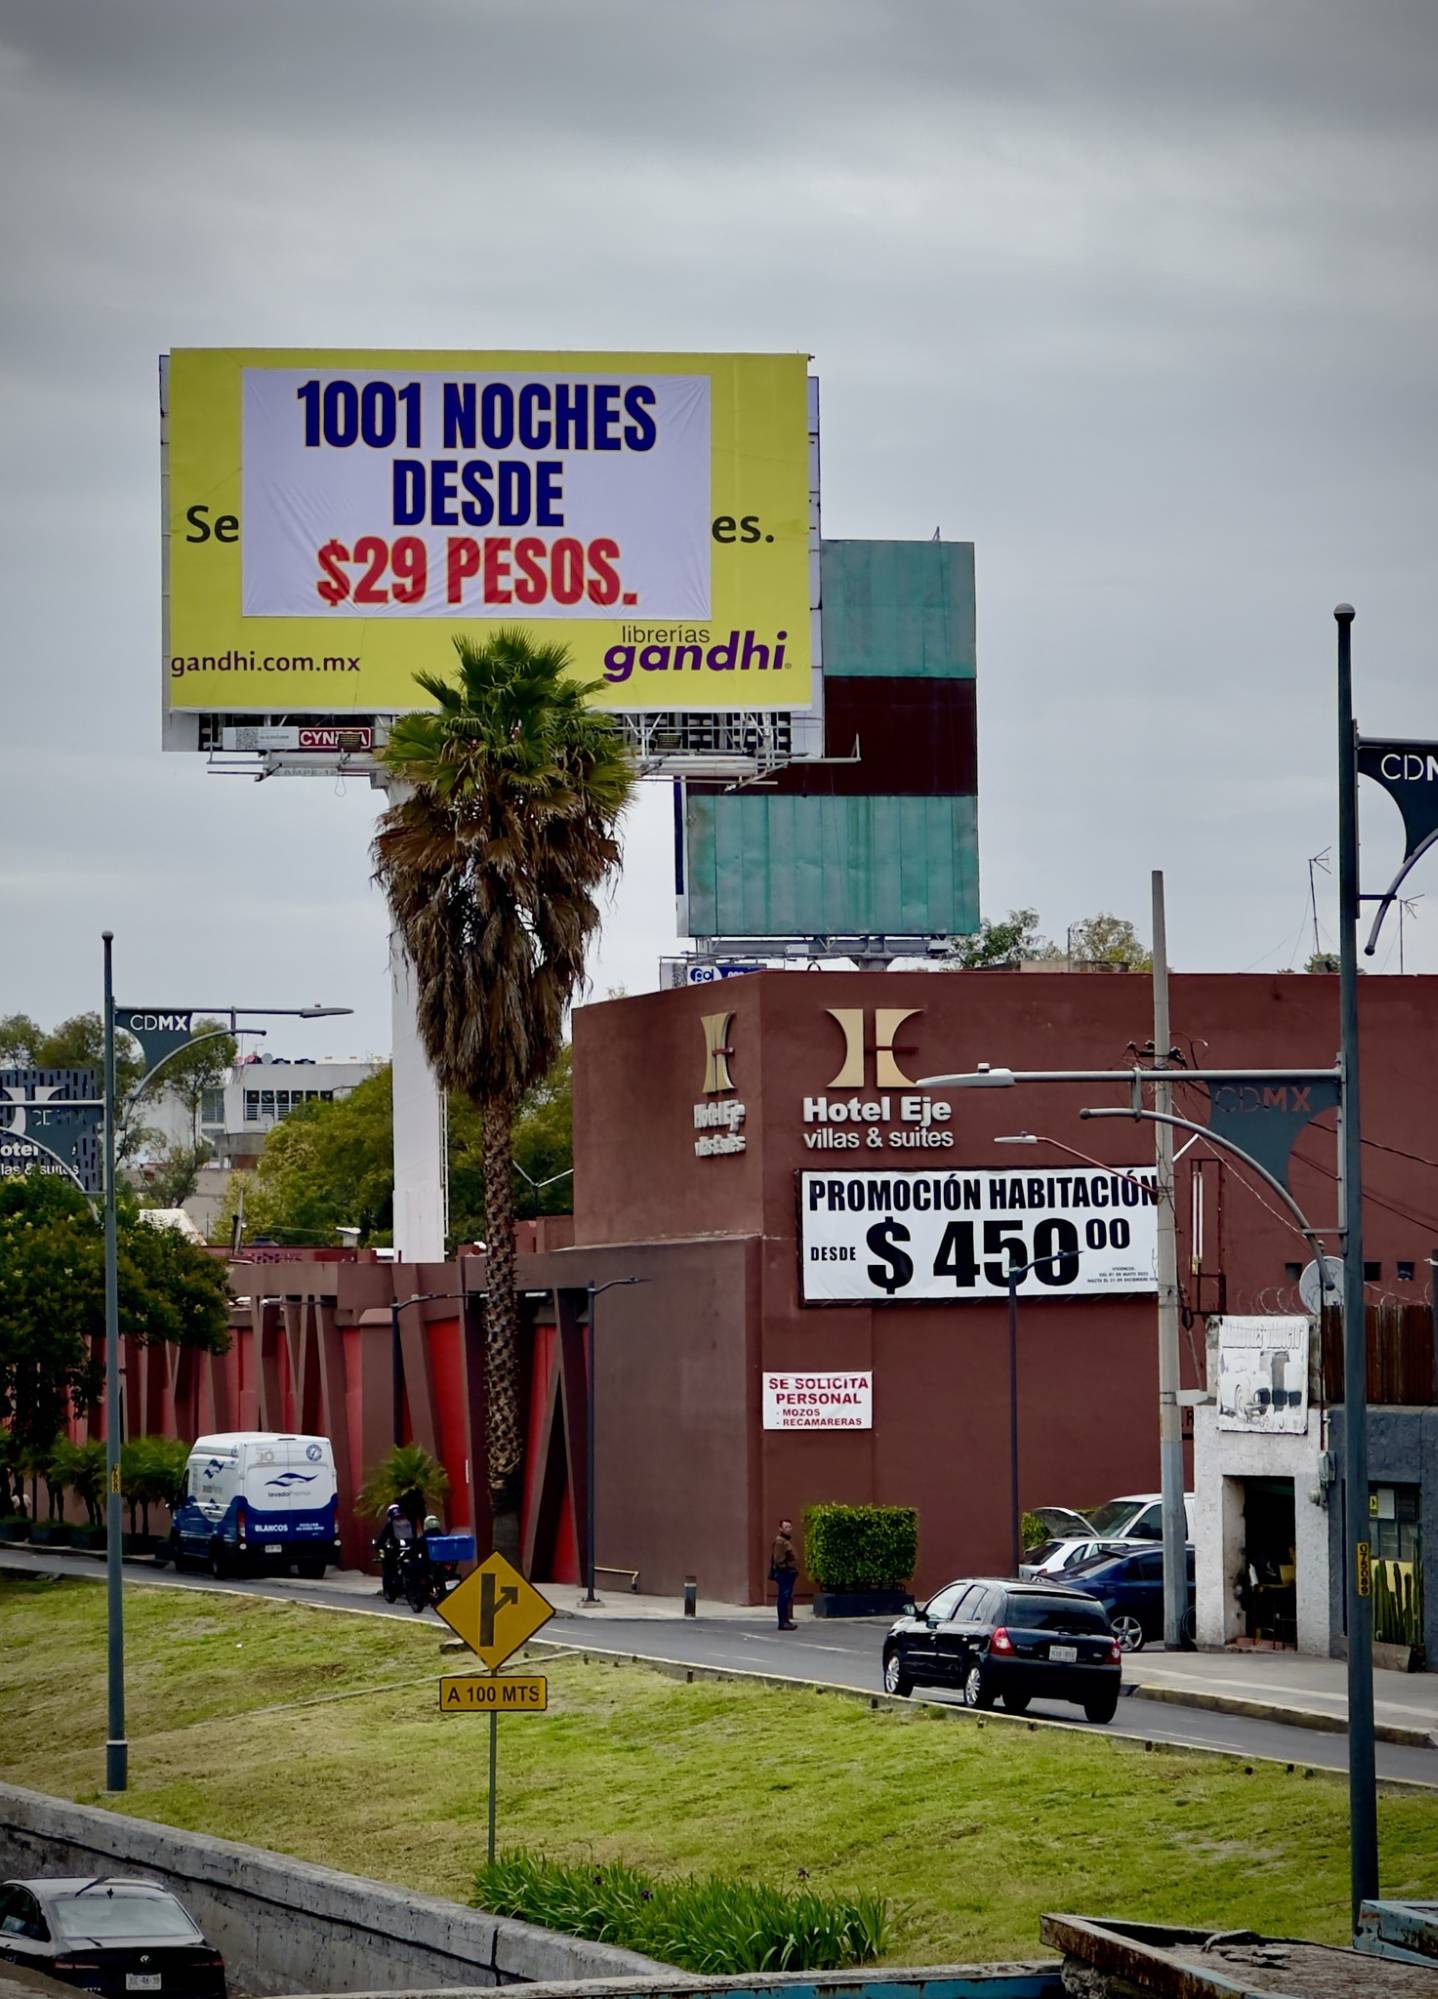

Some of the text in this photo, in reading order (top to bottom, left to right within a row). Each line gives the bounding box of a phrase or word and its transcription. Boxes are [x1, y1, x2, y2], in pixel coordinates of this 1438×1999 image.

[296, 379, 657, 452] 1001 NOCHES
[392, 459, 565, 528] DESDE
[185, 505, 240, 544] Se
[711, 514, 776, 544] es.
[316, 536, 638, 607] $29 PESOS.
[621, 625, 710, 643] librerías
[170, 650, 361, 678] gandhi.com.mx
[603, 630, 788, 683] gandhi
[130, 1014, 189, 1031] CDMX
[803, 1096, 952, 1127] Hotel Eje
[1215, 1086, 1313, 1112] CDMX
[803, 1125, 955, 1148] villas & suites
[809, 1169, 1158, 1212] PROMOCIÓN HABITACIÓN
[810, 1216, 1131, 1295] DESDE $ 450 00
[769, 1378, 869, 1390] SE SOLICITA
[776, 1393, 862, 1405] PERSONAL
[782, 1408, 821, 1417] MOZOS
[783, 1417, 863, 1427] RECAMARERAS
[447, 1685, 540, 1702] A 100 MTS
